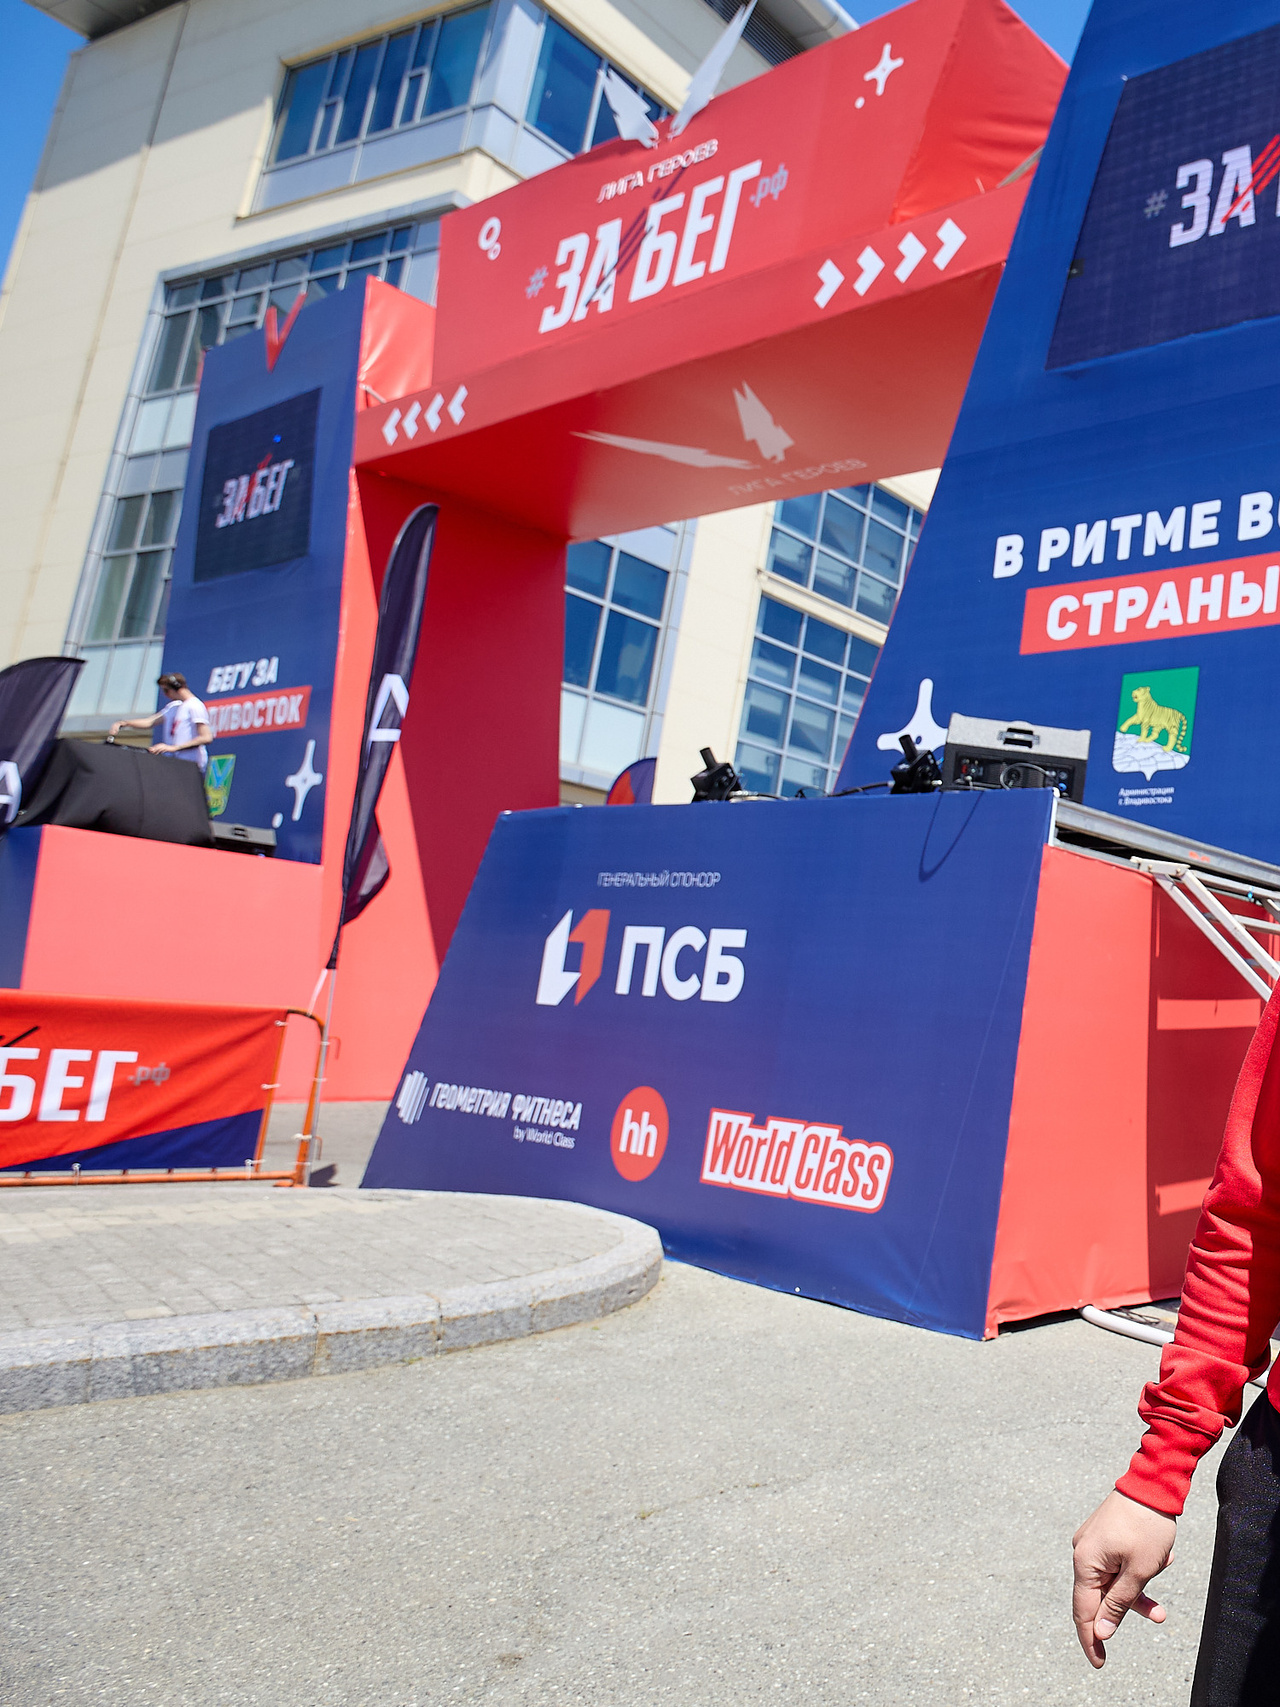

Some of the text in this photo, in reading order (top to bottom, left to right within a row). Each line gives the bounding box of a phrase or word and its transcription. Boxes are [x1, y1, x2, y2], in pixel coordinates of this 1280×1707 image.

[597, 139, 718, 203] ЛИГА ГЕРОЕВ
[992, 533, 1025, 579] В
[1037, 499, 1222, 573] РИТМЕ
[206, 656, 280, 694] БЕГУ ЗА
[597, 869, 670, 888] ГЕНЕРАЛЬНЫЙ
[615, 924, 748, 1004] ПСБ
[513, 1125, 576, 1149] by World Class
[619, 1108, 658, 1157] hh
[708, 1119, 886, 1201] World Class
